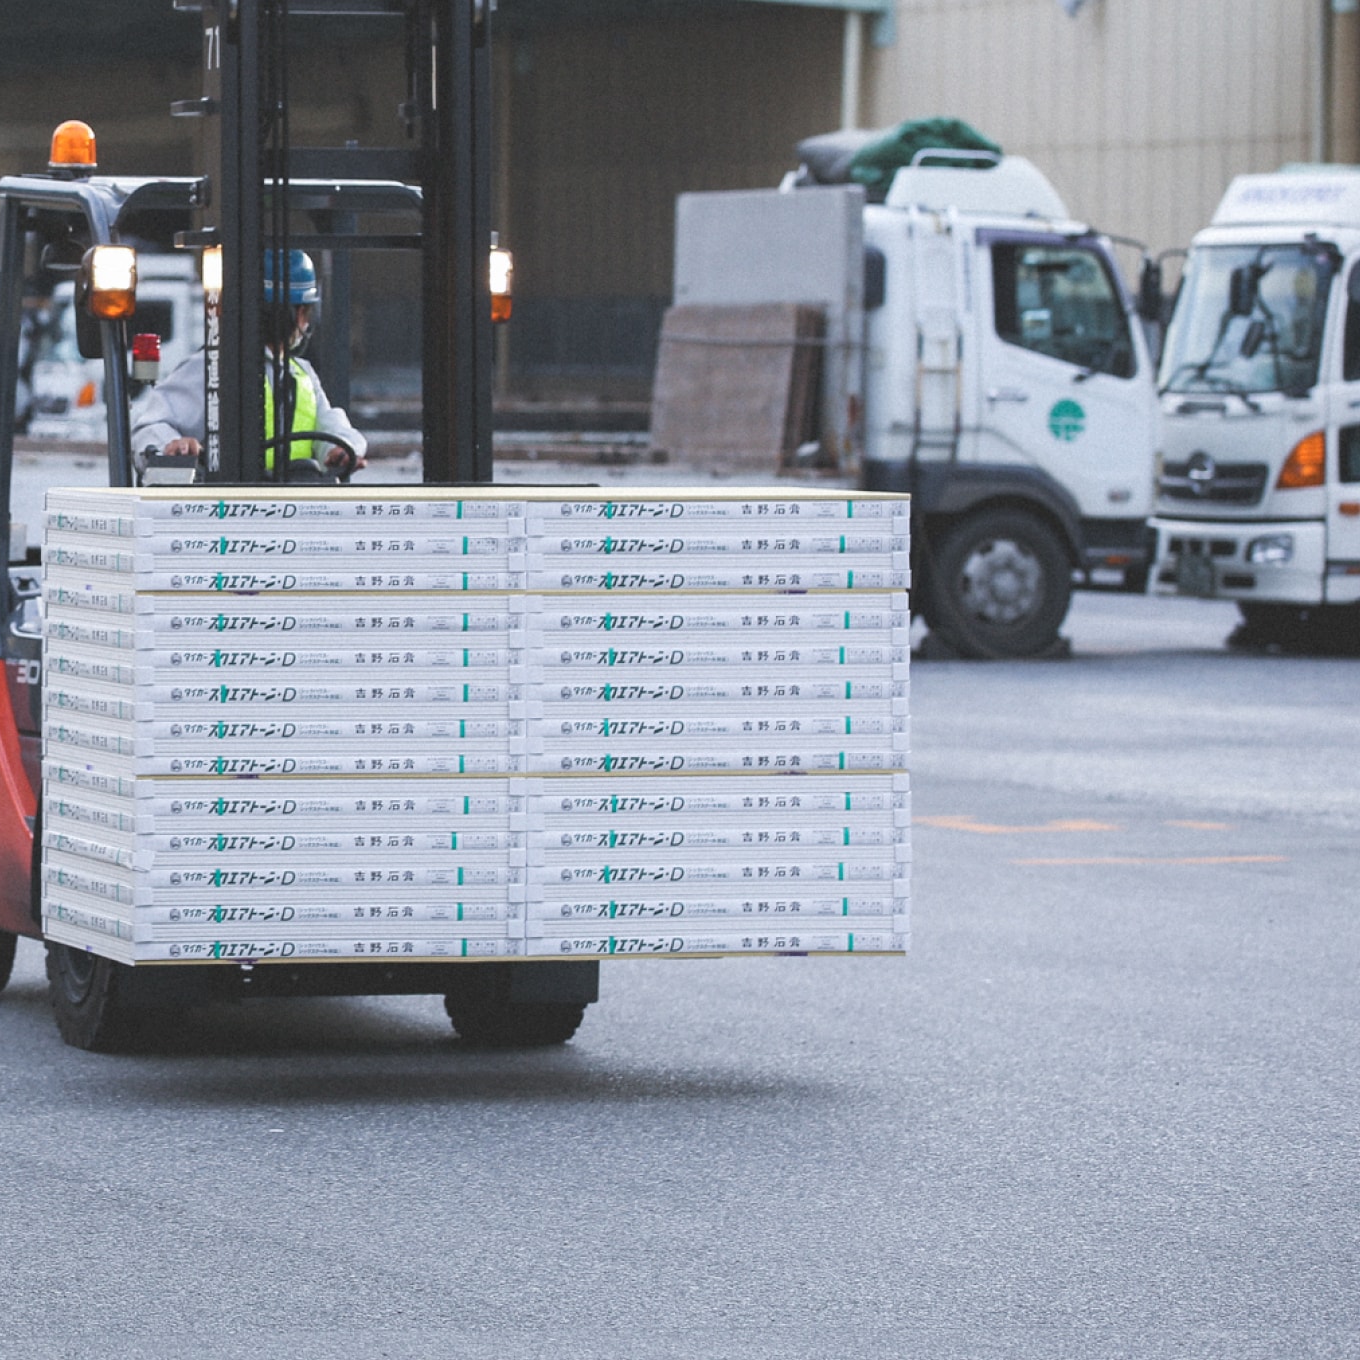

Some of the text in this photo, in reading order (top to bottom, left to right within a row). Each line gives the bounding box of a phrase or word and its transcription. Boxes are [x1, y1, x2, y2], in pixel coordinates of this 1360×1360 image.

[354, 504, 416, 516] 吉野石膏
[741, 504, 801, 515] 吉野石膏
[354, 540, 416, 552] 吉野石膏
[741, 540, 801, 551] 吉野石膏
[354, 576, 416, 588] 吉野石膏
[741, 575, 801, 586] 吉野石膏
[354, 617, 416, 629] 吉野石膏
[741, 615, 801, 626] 吉野石膏
[354, 653, 416, 665] 吉野石膏
[741, 650, 801, 661] 吉野石膏
[354, 688, 416, 700] 吉野石膏
[741, 686, 801, 697] 吉野石膏
[354, 723, 416, 735] 吉野石膏
[741, 721, 801, 732] 吉野石膏
[354, 759, 416, 771] 吉野石膏
[741, 756, 801, 767] 吉野石膏
[354, 801, 416, 813] 吉野石膏
[741, 797, 801, 808] 吉野石膏
[354, 836, 416, 848] 吉野石膏
[741, 832, 801, 843] 吉野石膏
[353, 872, 415, 884] 吉野石膏
[741, 867, 801, 878] 吉野石膏
[353, 907, 415, 919] 吉野石膏
[741, 902, 801, 913] 吉野石膏
[353, 942, 415, 954] 吉野石膏
[741, 937, 801, 948] 吉野石膏
